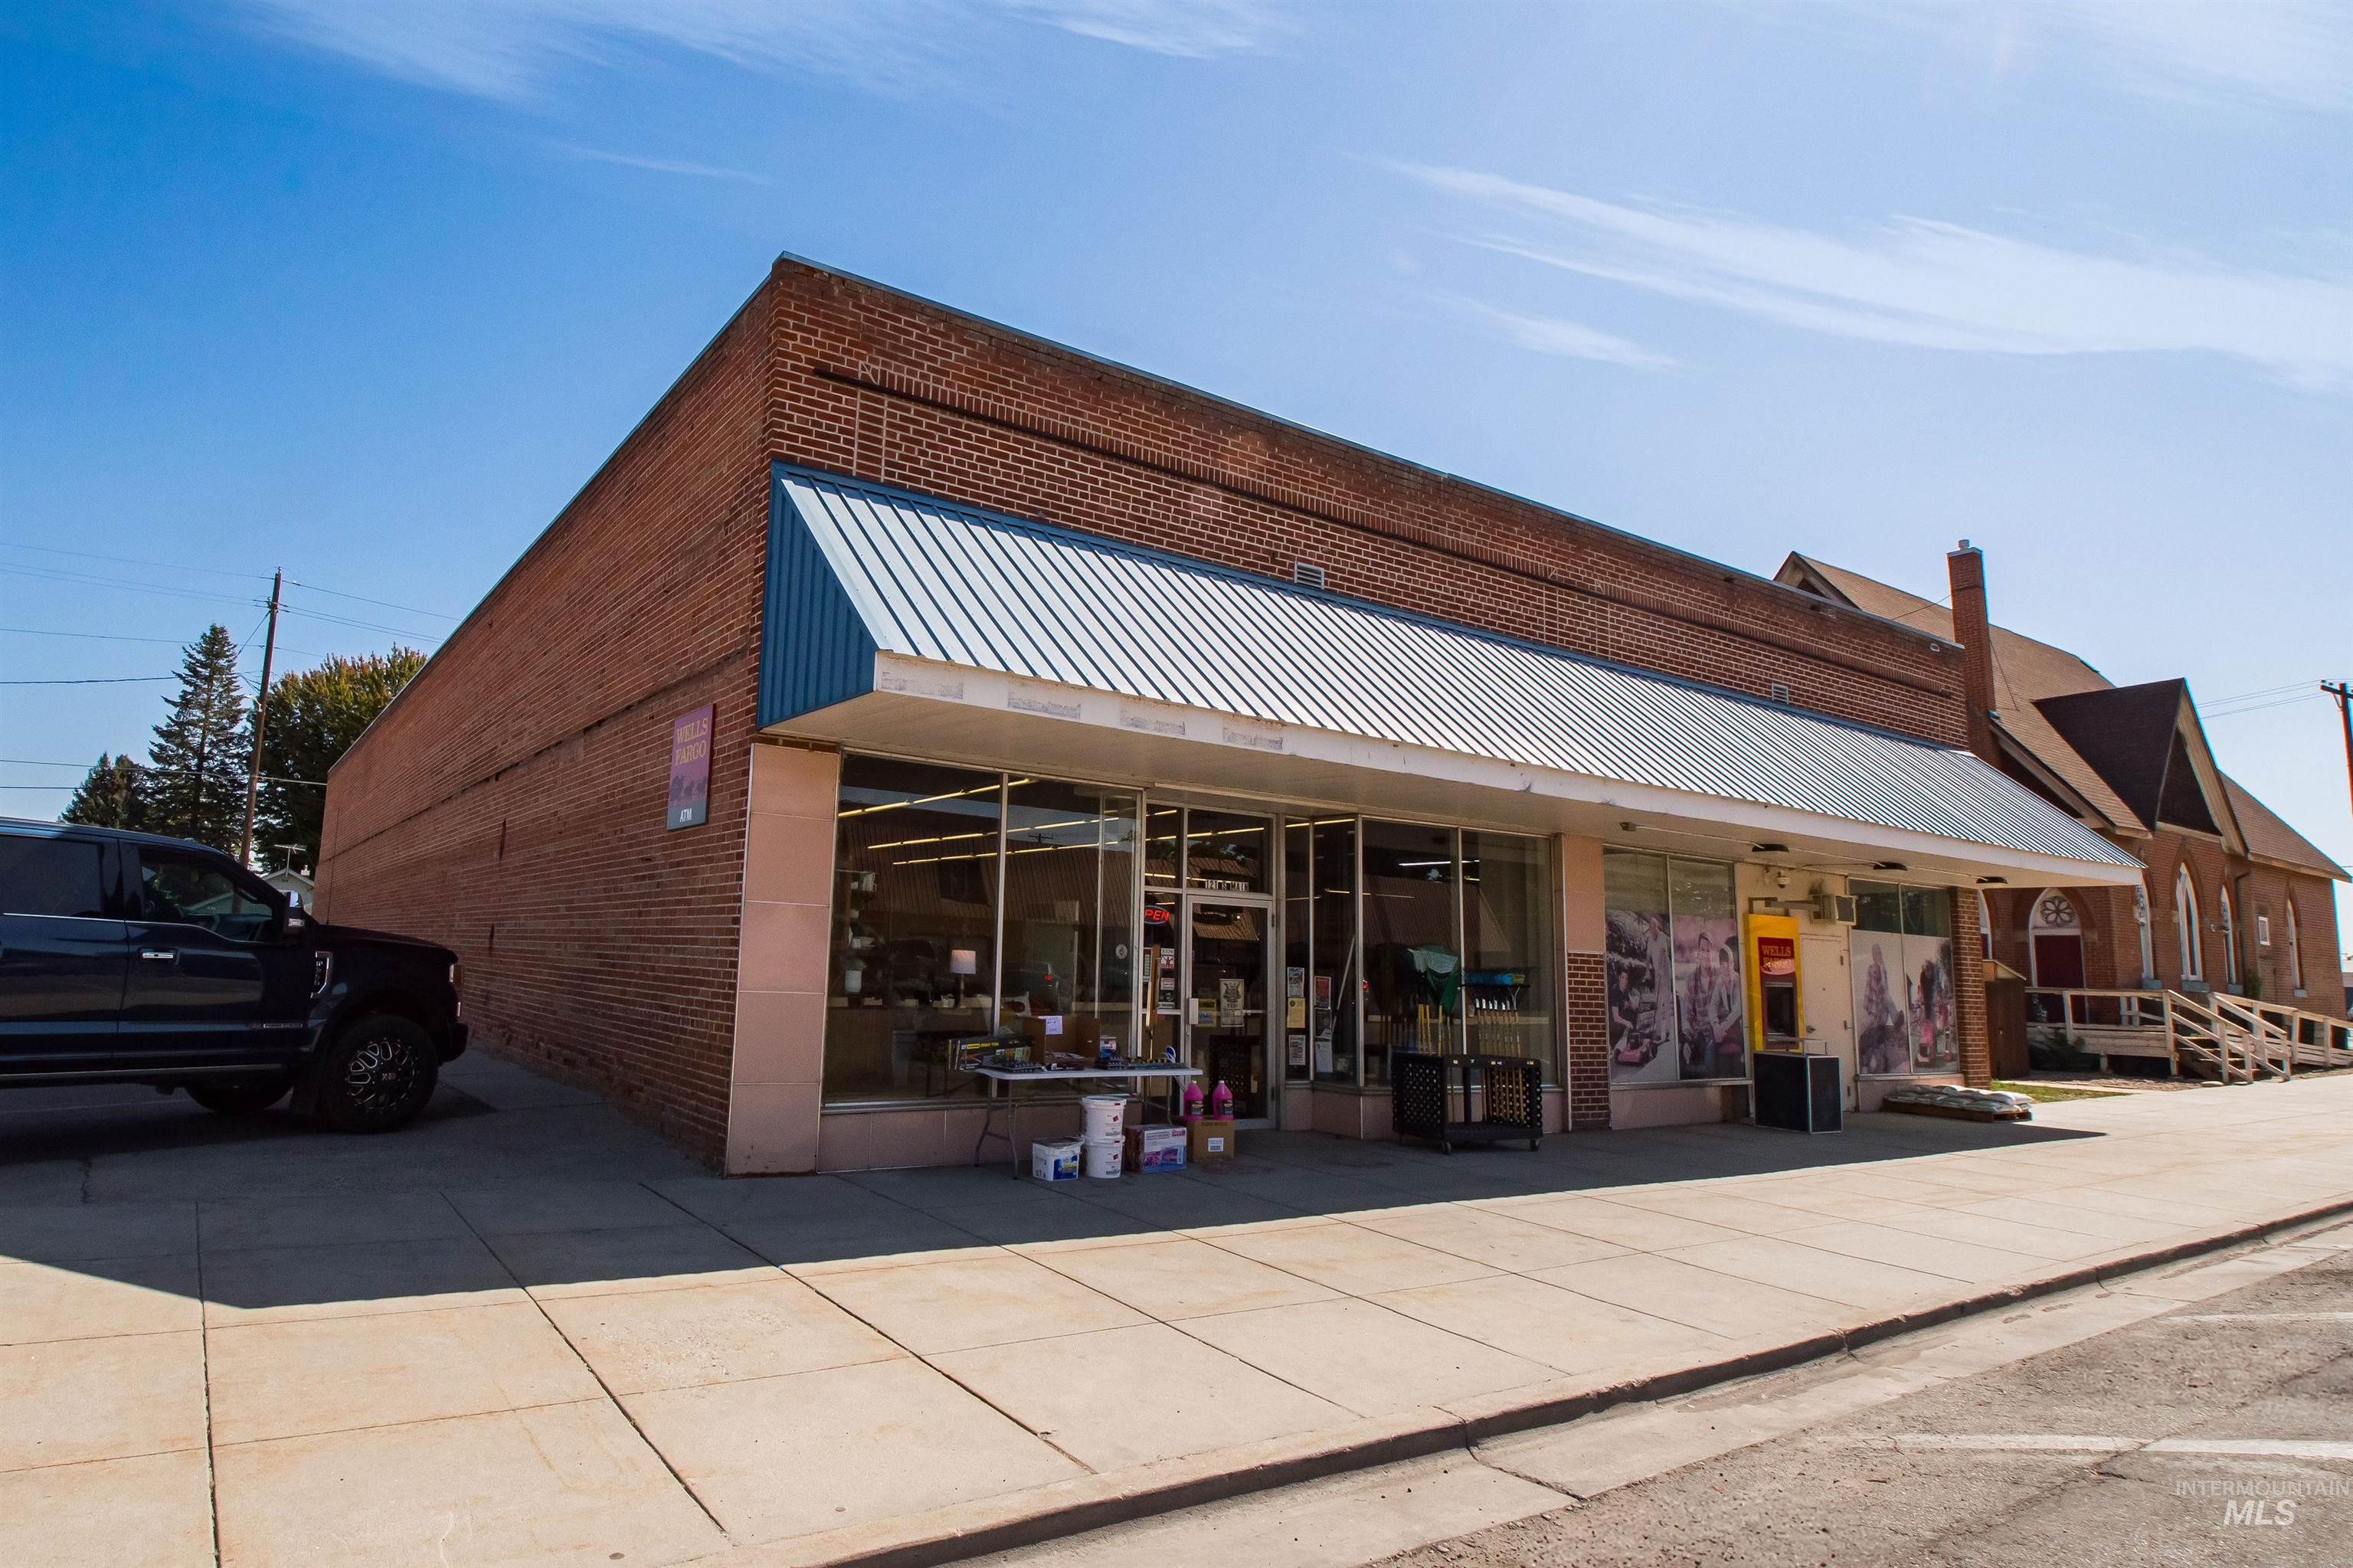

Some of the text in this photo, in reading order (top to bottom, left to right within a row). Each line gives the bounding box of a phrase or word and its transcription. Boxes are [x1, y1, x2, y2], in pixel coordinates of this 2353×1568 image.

[676, 717, 709, 744] WELLS
[675, 739, 707, 766] FARGO
[679, 808, 692, 823] ATM
[1206, 879, 1218, 889] 121
[1231, 882, 1249, 892] MAIN
[1144, 909, 1170, 921] PEN
[1761, 944, 1792, 957] WELLS
